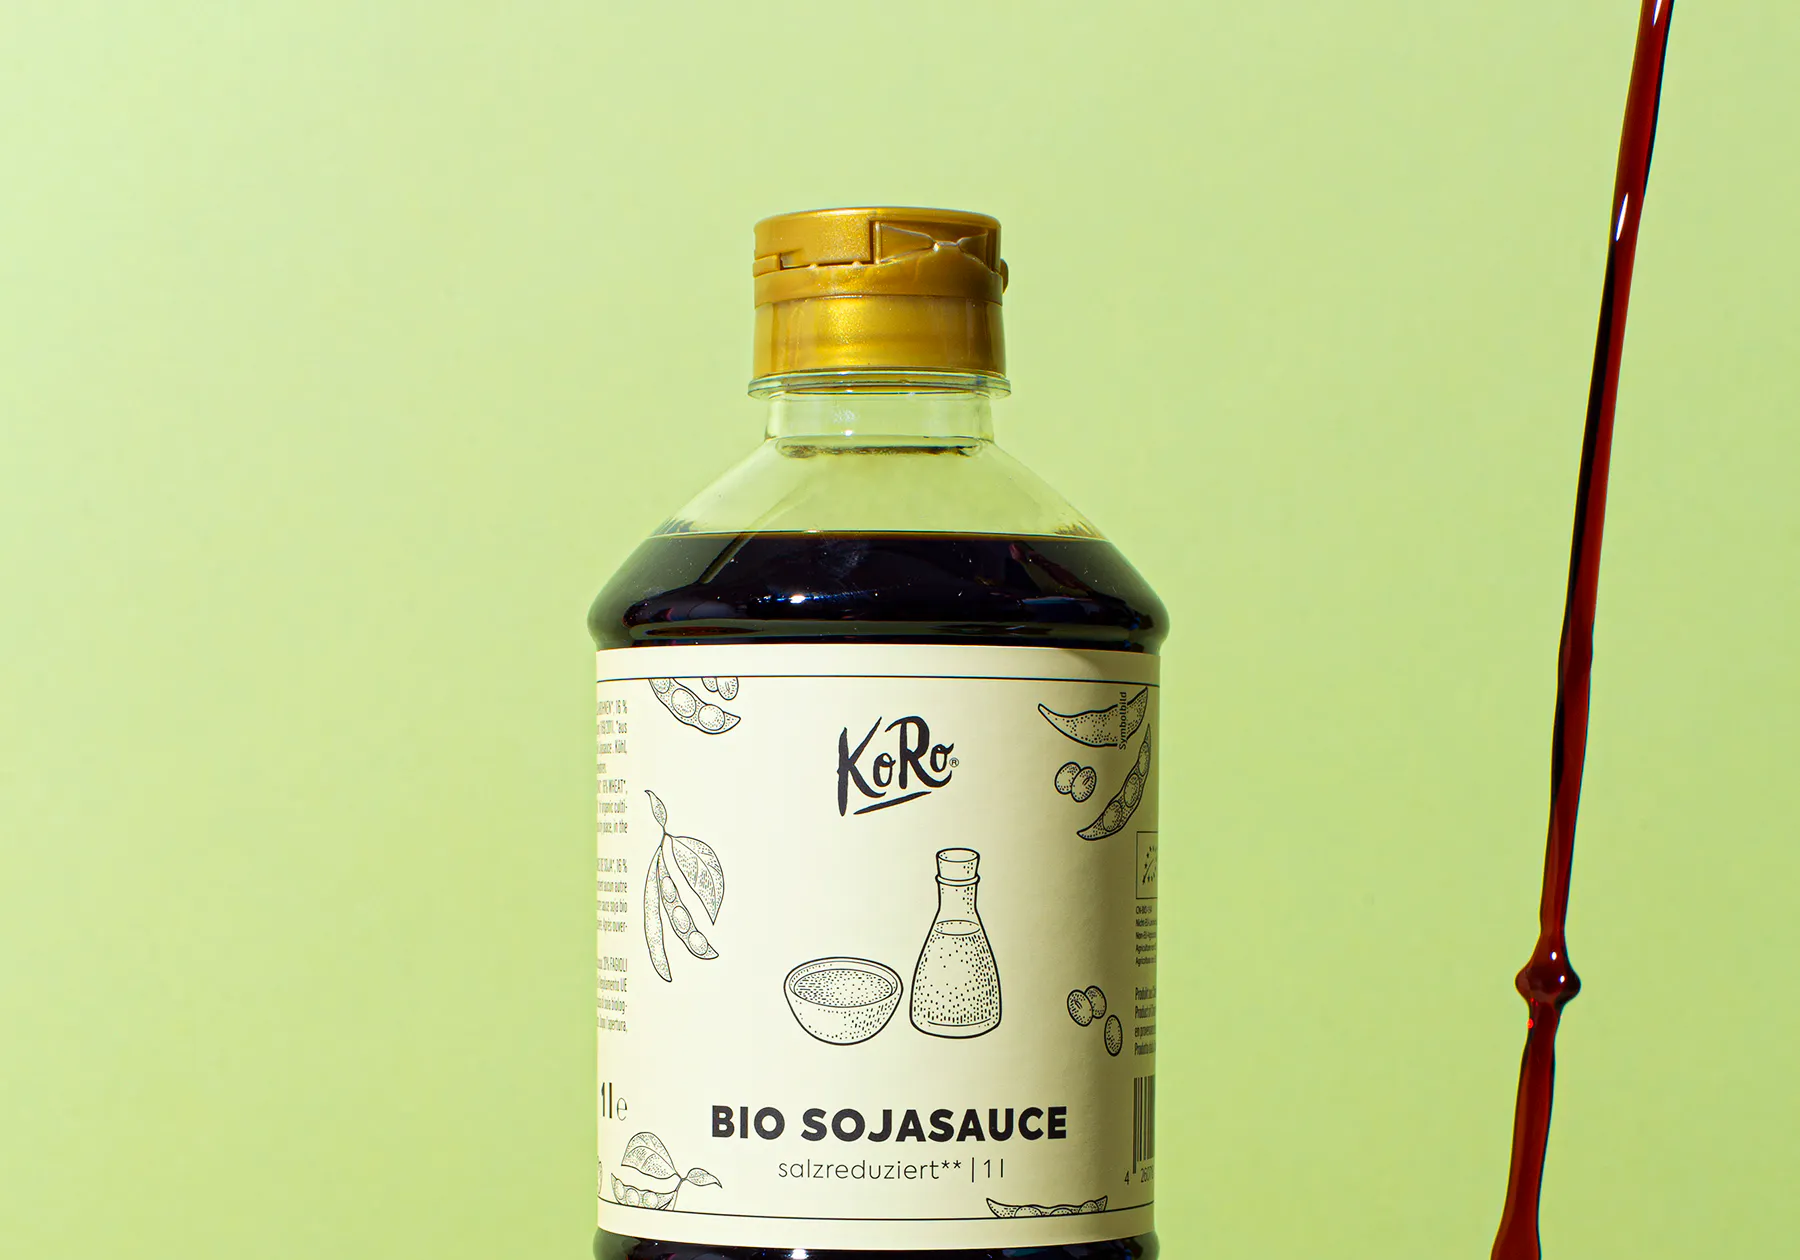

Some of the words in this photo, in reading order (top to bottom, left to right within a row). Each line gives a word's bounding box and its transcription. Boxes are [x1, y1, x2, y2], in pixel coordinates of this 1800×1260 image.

[1119, 691, 1128, 750] Symbolbild
[619, 819, 628, 833] the
[614, 880, 628, 893] autre
[619, 898, 627, 913] bio
[711, 1105, 785, 1140] BIO
[800, 1106, 1067, 1142] SOJASAUCE
